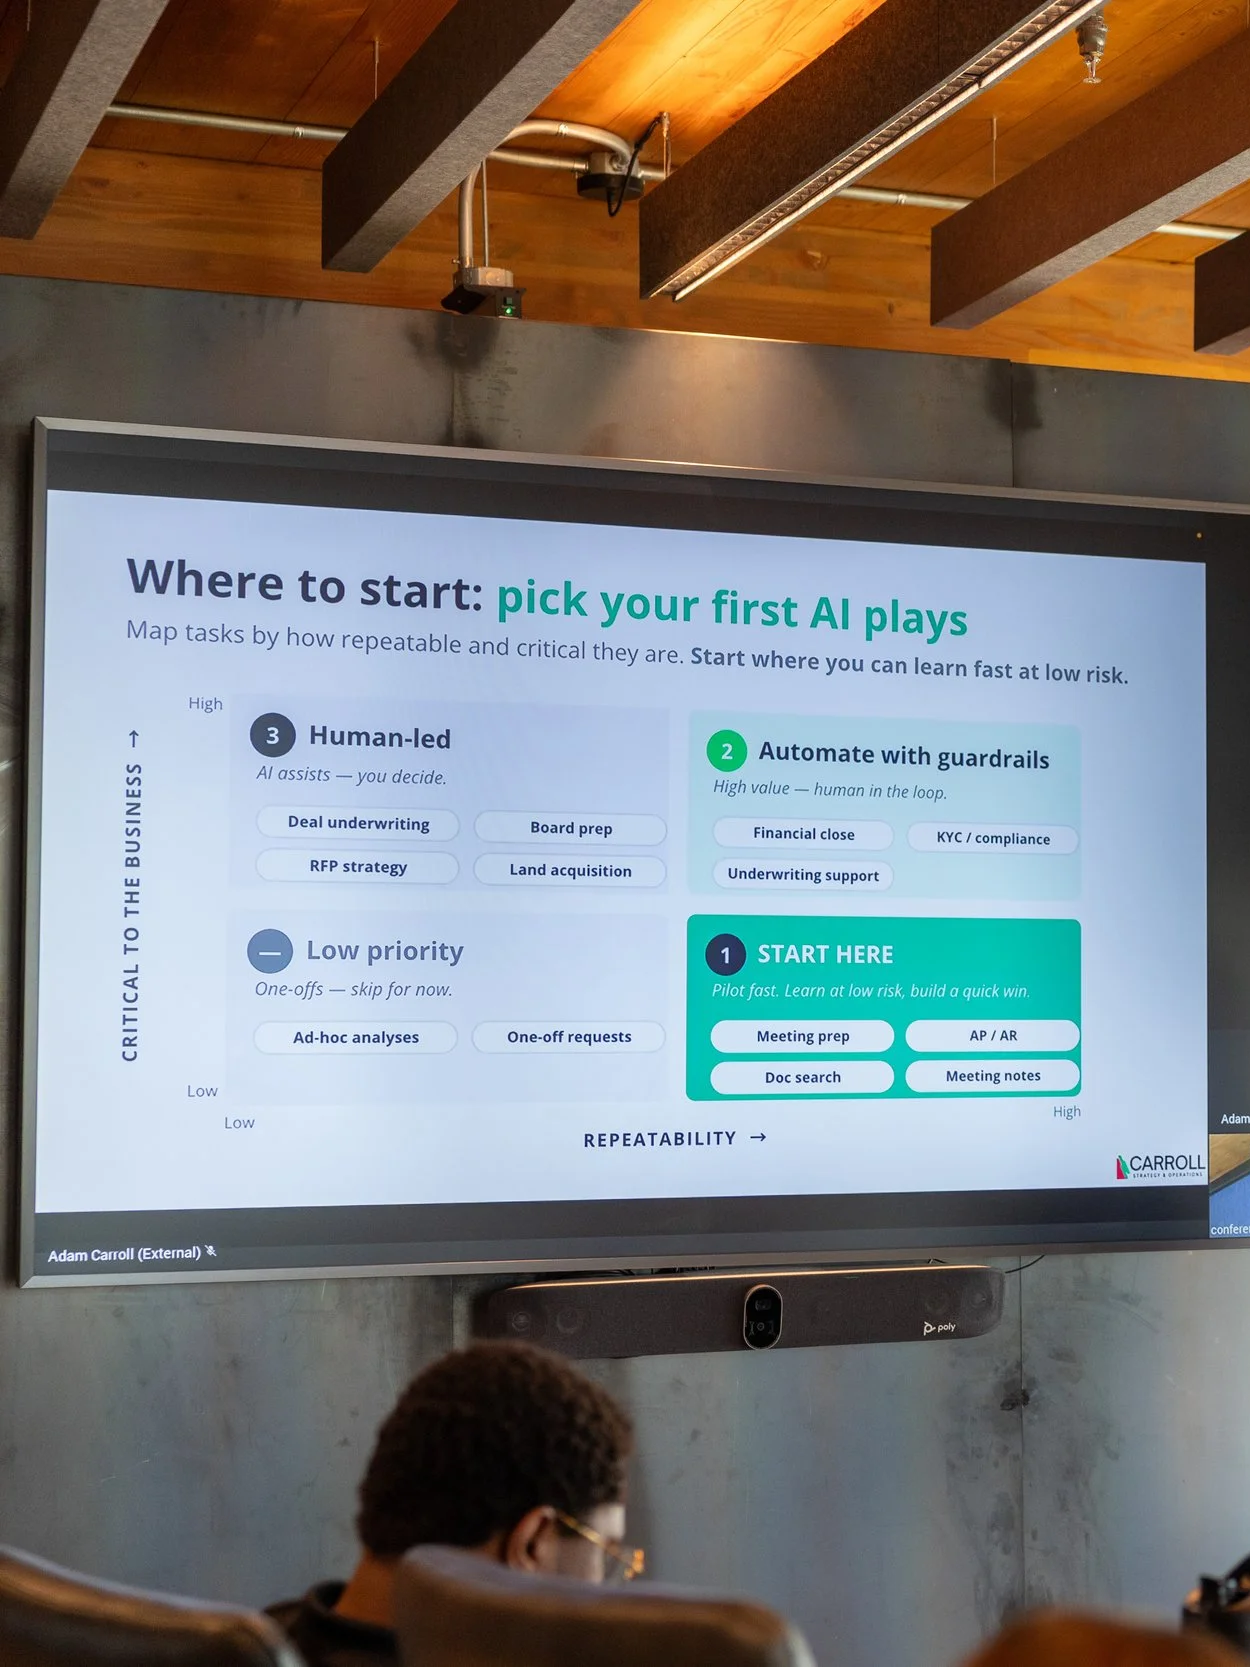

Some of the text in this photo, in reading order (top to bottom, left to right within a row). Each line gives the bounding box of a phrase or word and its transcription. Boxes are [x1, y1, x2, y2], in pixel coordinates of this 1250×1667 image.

[127, 559, 967, 644] Where to start: pick your first AI plays
[128, 620, 1129, 685] Map tasks by how repeatable and critical they are. Start where you can learn fast at low risk.
[189, 696, 223, 714] High
[266, 726, 280, 745] 3
[310, 725, 451, 750] Human-led
[721, 742, 734, 761] 2
[758, 741, 1050, 772] Automate with guardrails
[255, 765, 274, 780] AI
[277, 766, 331, 782] assists
[355, 771, 387, 787] you
[391, 768, 446, 785] decide.
[713, 779, 747, 798] High
[751, 780, 790, 795] value
[813, 781, 865, 797] human
[869, 783, 883, 798] in
[886, 784, 909, 799] the
[912, 784, 947, 803] loop.
[288, 815, 430, 835] Deal underwriting
[530, 821, 613, 839] Board prep
[753, 826, 855, 841] Financial close
[937, 831, 963, 843] KYC
[975, 832, 1051, 848] compliance
[310, 859, 408, 877] RFP strategy
[510, 863, 632, 880] Land acquisition
[728, 867, 880, 885] Underwriting support
[122, 764, 141, 1061] CRITICAL TO THE BUSINESS
[307, 940, 464, 966] Low priority
[720, 946, 730, 964] 1
[758, 943, 895, 965] START HERE
[255, 980, 324, 1001] One-offs
[350, 981, 383, 1001] skip
[385, 981, 412, 1001] for
[415, 985, 452, 997] now.
[711, 982, 1030, 1002] Pilot fast. Learn at low risk, build a quick win.
[292, 1030, 420, 1048] Ad-hoc analyses
[507, 1030, 632, 1047] One-off requests
[757, 1029, 850, 1046] Meeting prep
[969, 1029, 988, 1042] AP
[999, 1029, 1018, 1041] AR
[765, 1070, 841, 1084] Doc search
[946, 1069, 1041, 1085] Meeting notes
[187, 1084, 219, 1098] Low
[1053, 1105, 1082, 1121] High
[1220, 1113, 1250, 1125] Adam
[224, 1116, 256, 1130] Low
[584, 1130, 736, 1148] REPEATABILITY
[1129, 1154, 1206, 1172] CARROLL
[47, 1245, 202, 1263] Adam Carroll (External)
[937, 1322, 957, 1333] poly
